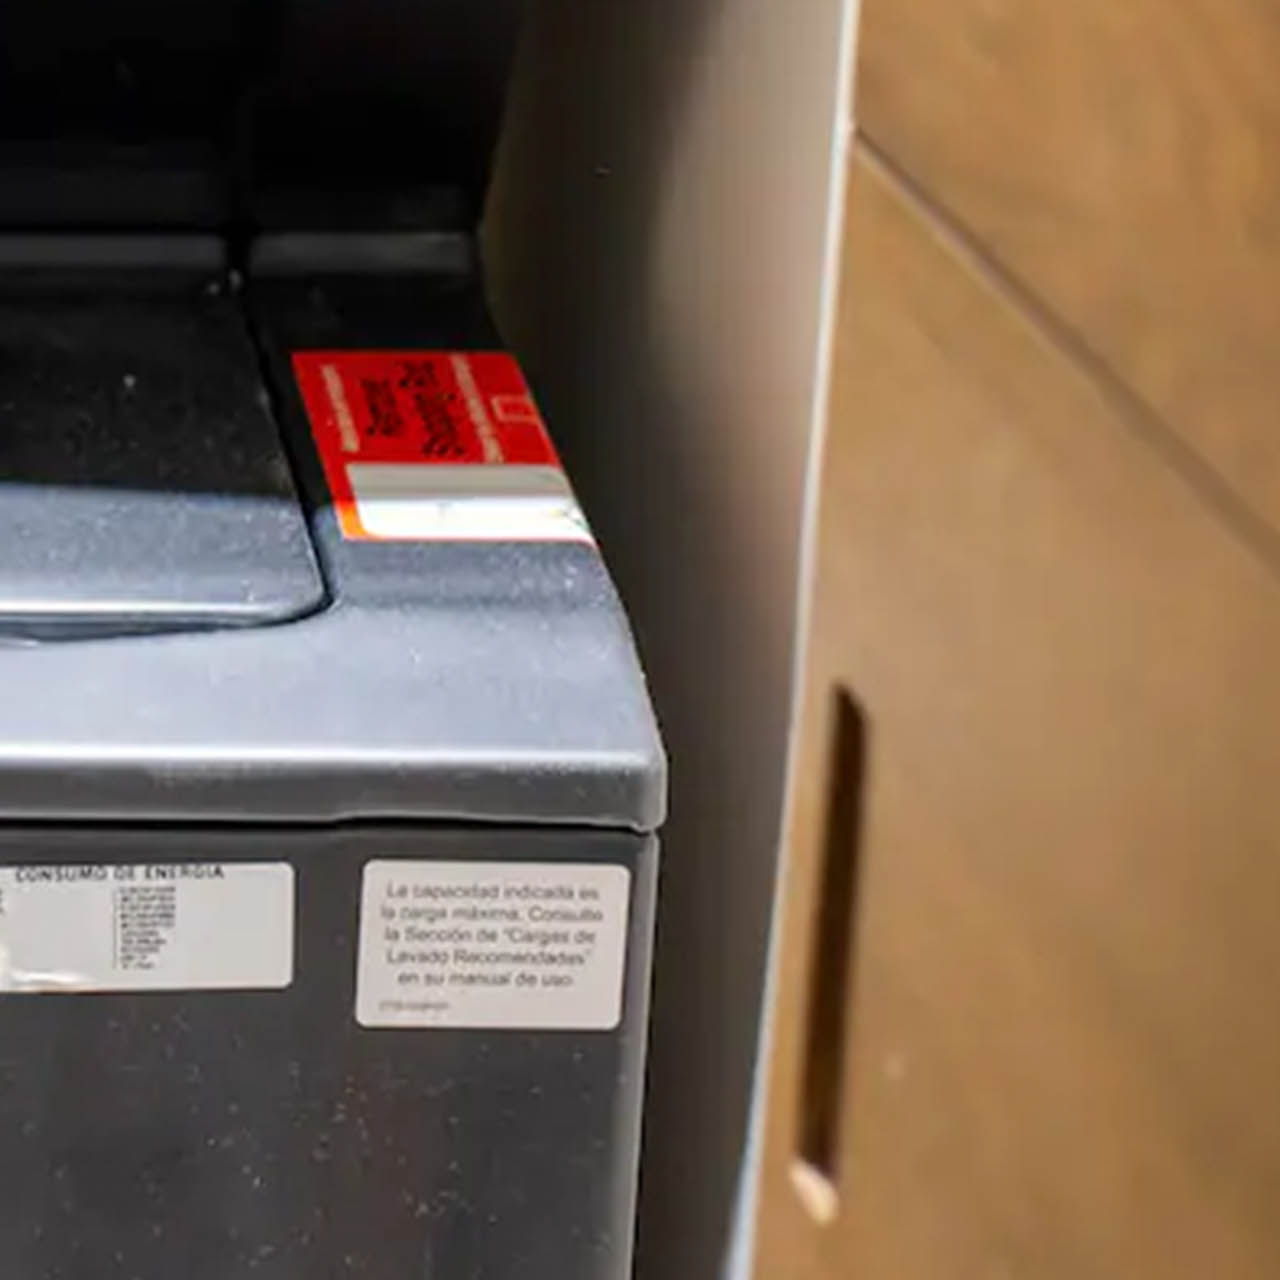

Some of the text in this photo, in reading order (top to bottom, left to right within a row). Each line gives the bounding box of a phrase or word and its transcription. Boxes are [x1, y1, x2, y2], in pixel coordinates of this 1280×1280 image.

[386, 882, 600, 902] La capacidad indicada es
[380, 904, 396, 919] la
[399, 908, 448, 924] carga
[451, 905, 521, 921] máxima.
[384, 926, 400, 942] la
[403, 926, 473, 944] Sección
[476, 926, 498, 943] de
[574, 928, 596, 945] de
[386, 947, 450, 966] Lavado
[397, 971, 420, 985] en
[424, 972, 444, 987] su
[448, 971, 510, 986] manual
[515, 970, 538, 987] de
